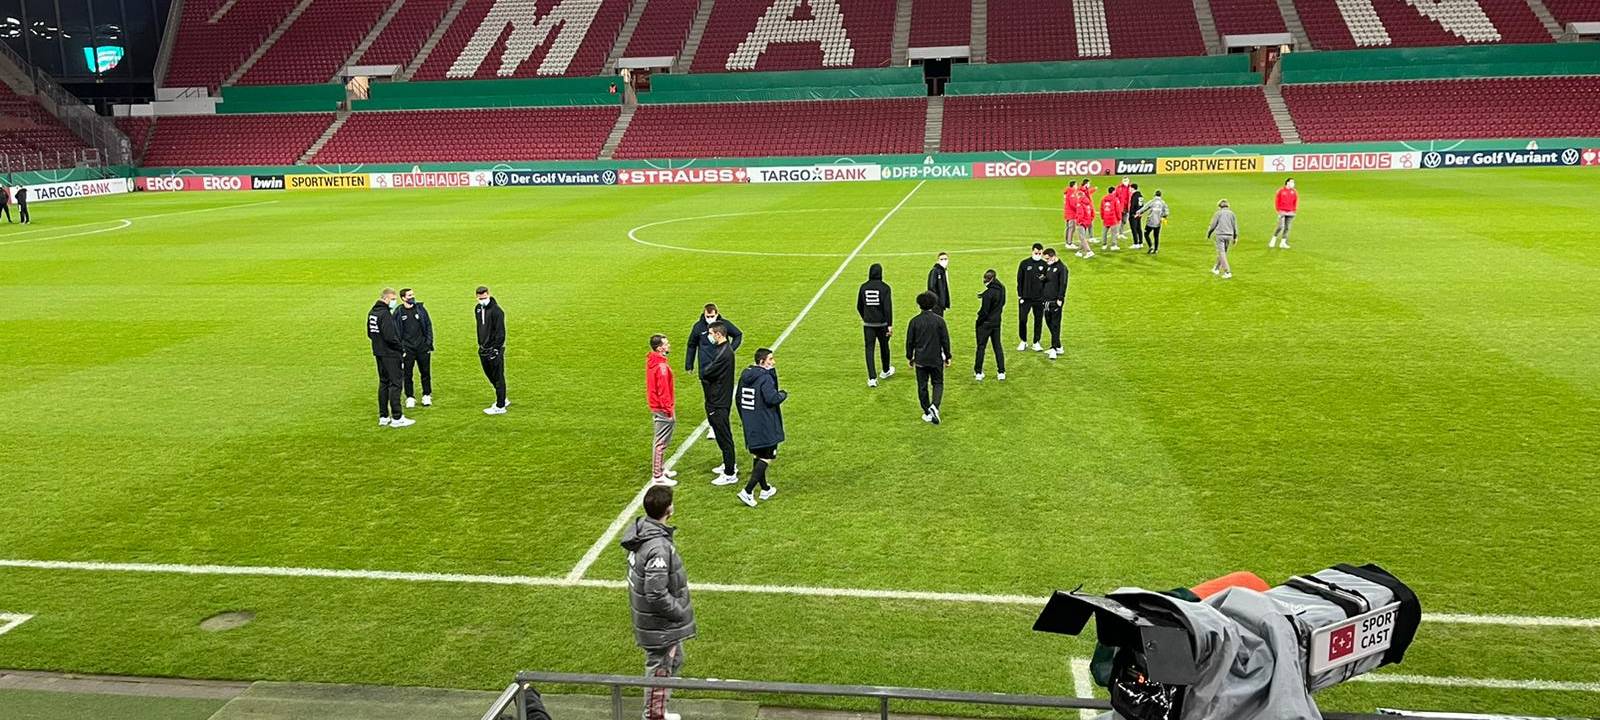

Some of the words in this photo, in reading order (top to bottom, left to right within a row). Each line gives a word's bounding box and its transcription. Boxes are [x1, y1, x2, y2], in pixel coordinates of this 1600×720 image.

[1165, 158, 1257, 171] SPORTWETTEN
[1293, 153, 1392, 170] BAUHAUS
[1445, 154, 1470, 165] Der
[1472, 153, 1503, 164] Golf
[1505, 151, 1558, 163] Variant
[892, 166, 968, 178] DFB-POKAL
[984, 163, 1031, 177] ERGO
[1055, 161, 1102, 175] ERGO
[1117, 160, 1154, 173] bwin
[203, 176, 241, 190] ERGO
[253, 176, 283, 189] bwin
[291, 176, 365, 188] SPORTWETTEN
[392, 174, 470, 187] BAUHAUS
[511, 174, 530, 184] Der
[532, 173, 556, 184] Golf
[558, 172, 599, 183] Variant
[631, 170, 733, 183] STRAUSS
[146, 177, 184, 190] ERGO
[1362, 609, 1399, 632] SPORT
[1361, 628, 1390, 648] CAST
